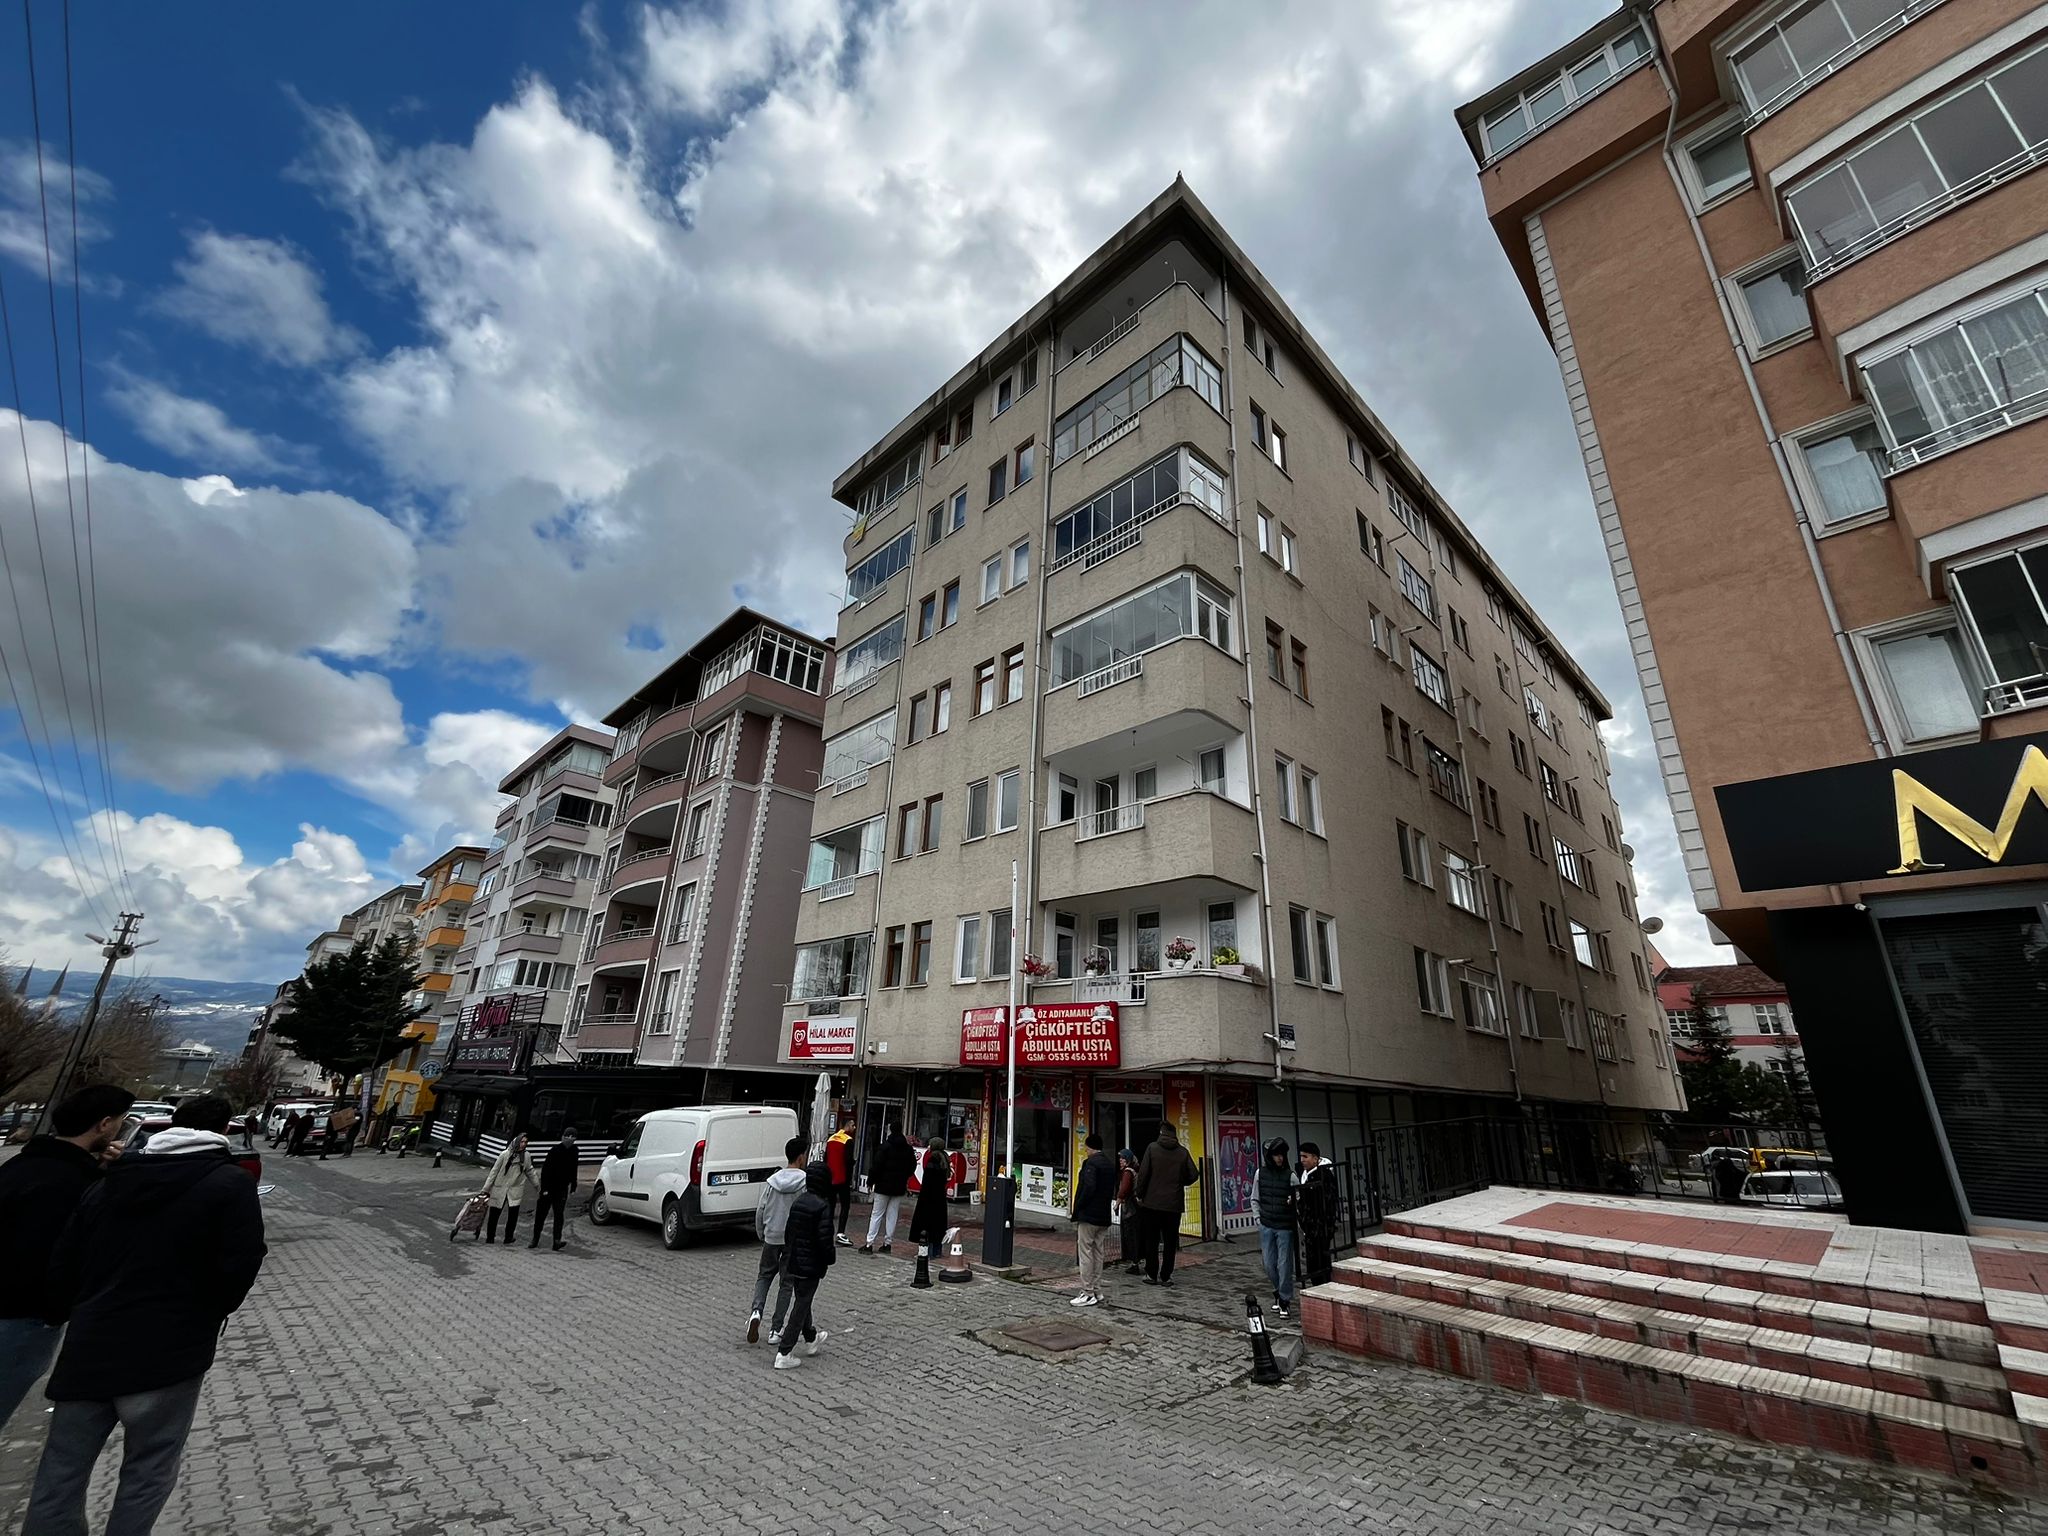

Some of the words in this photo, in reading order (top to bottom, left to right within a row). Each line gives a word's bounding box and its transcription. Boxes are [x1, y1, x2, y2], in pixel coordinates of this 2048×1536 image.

[1037, 1009, 1048, 1019] ÖZ
[827, 1027, 855, 1038] MARKET
[1022, 1040, 1080, 1052] ABDULLAH
[1082, 1039, 1113, 1051] USTA
[1048, 1053, 1070, 1061] 0535
[1071, 1053, 1087, 1061] 456
[1087, 1053, 1098, 1061] 33
[1099, 1052, 1108, 1061] 11
